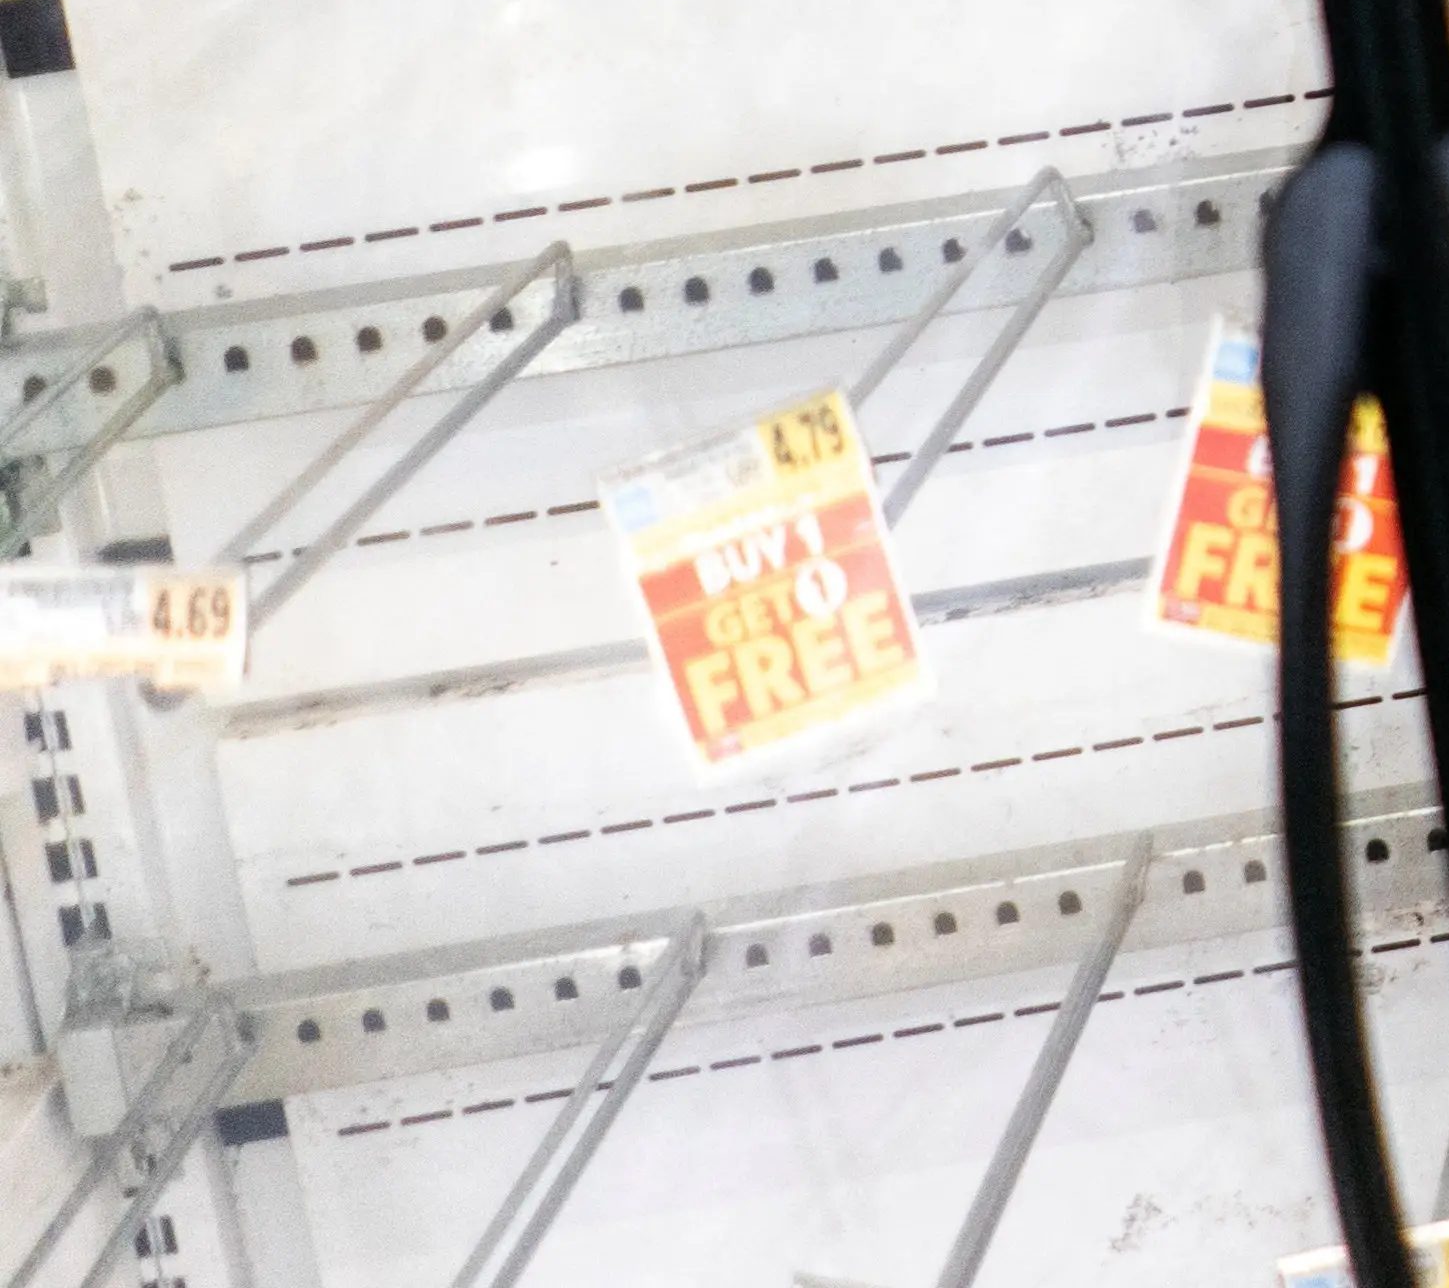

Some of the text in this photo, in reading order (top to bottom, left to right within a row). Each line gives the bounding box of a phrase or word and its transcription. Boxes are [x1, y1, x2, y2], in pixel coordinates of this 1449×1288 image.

[694, 512, 824, 595] BUY 1
[153, 584, 233, 642] 4.69
[705, 579, 796, 647] GET
[684, 589, 904, 739] FREE
